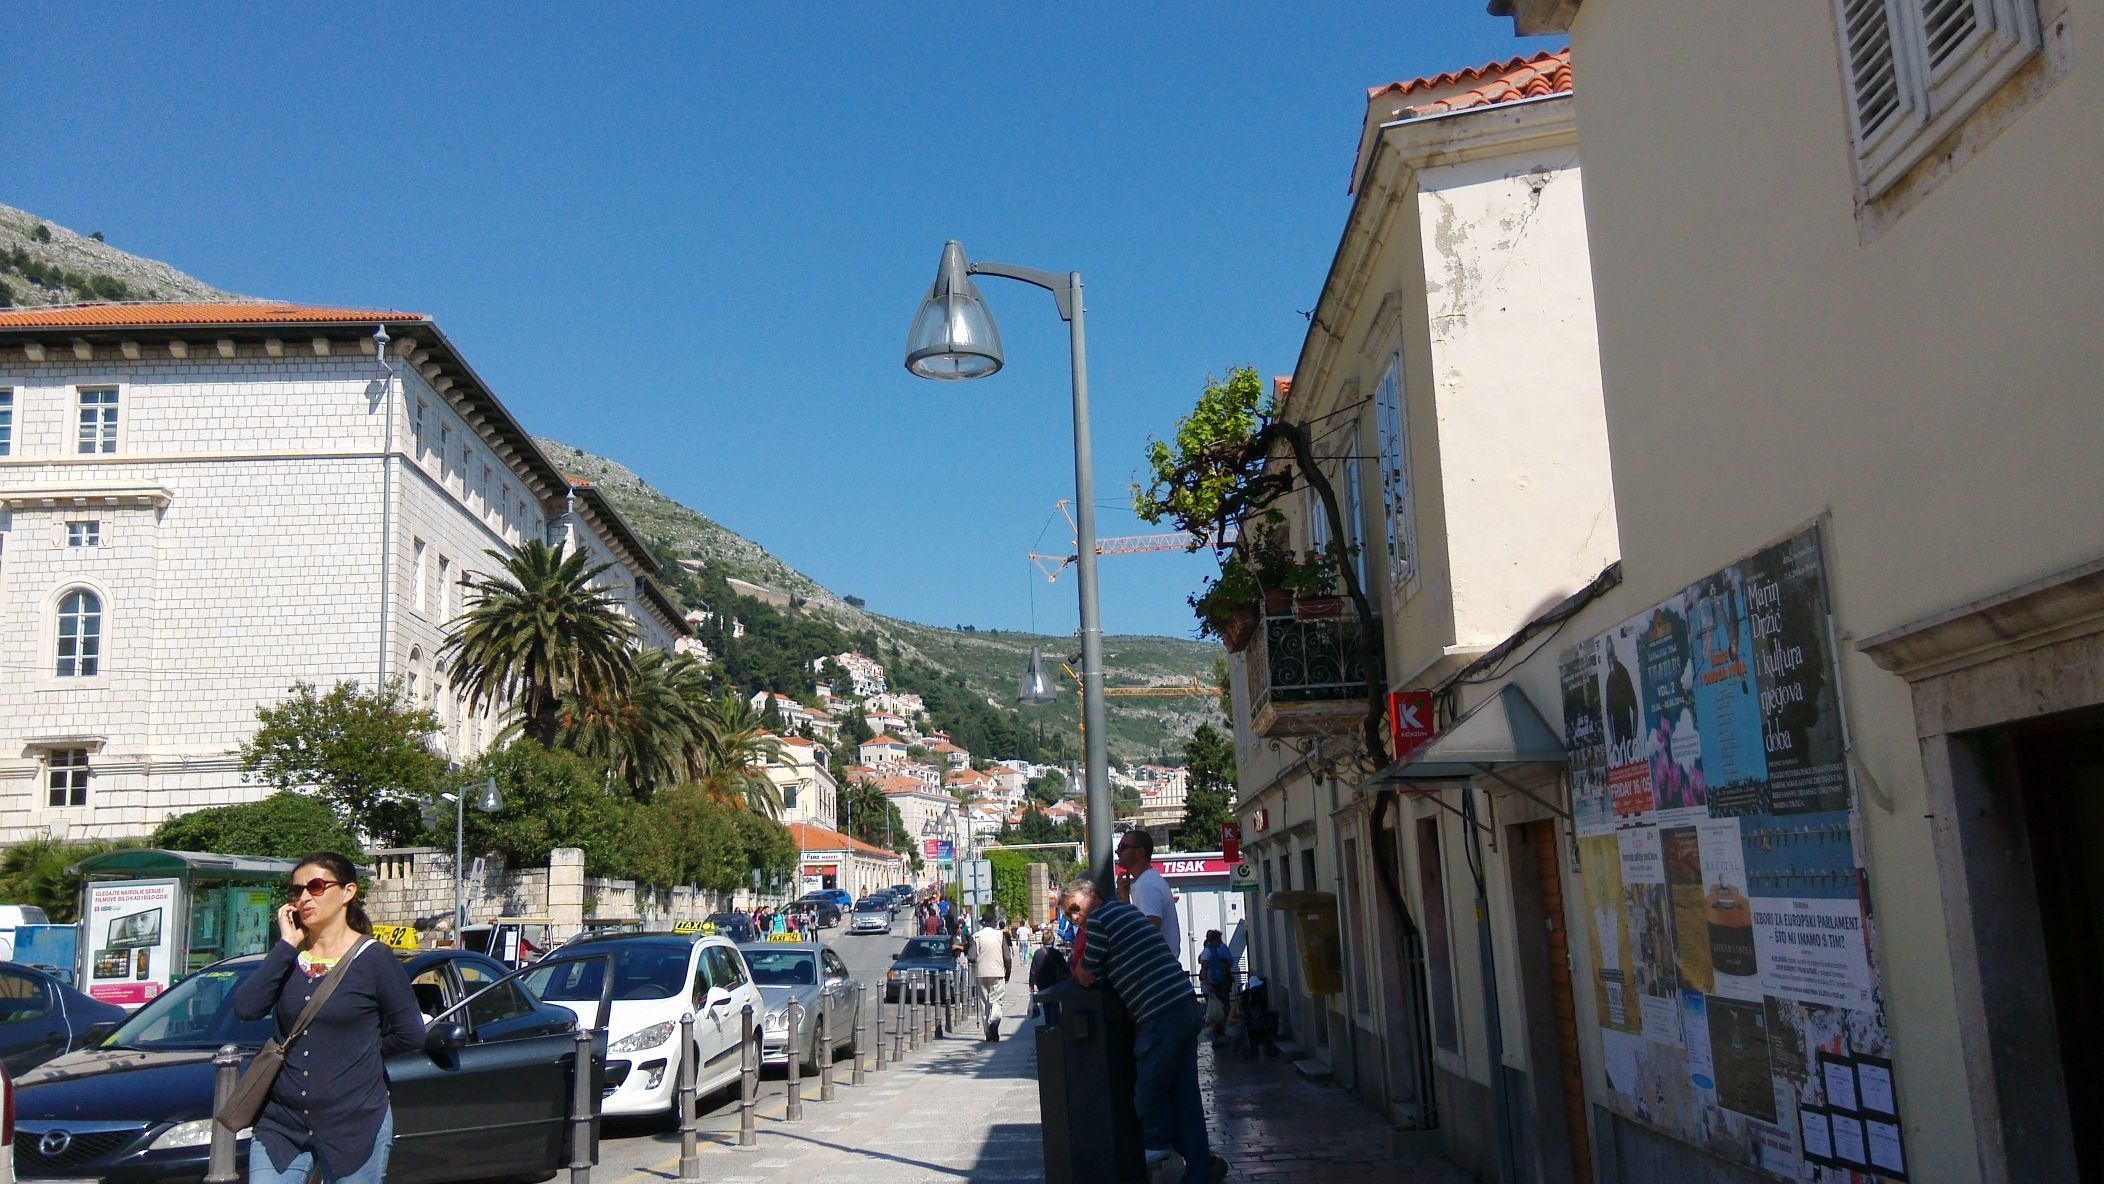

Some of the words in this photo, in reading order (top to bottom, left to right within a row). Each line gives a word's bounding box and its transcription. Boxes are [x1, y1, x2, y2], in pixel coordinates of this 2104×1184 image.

[1747, 579, 1780, 612] Marin
[1751, 608, 1781, 639] Držić
[1756, 652, 1761, 676] i
[1762, 638, 1803, 677] kultura
[1760, 681, 1803, 715] njegova
[1399, 704, 1424, 729] K
[1766, 717, 1792, 752] doba
[1611, 781, 1632, 799] FRIDAY
[1163, 860, 1205, 873] TISAK
[681, 921, 703, 930] TAXI
[1753, 912, 1774, 925] IZBORI
[1774, 913, 1783, 926] ZA
[1784, 914, 1816, 928] EUROPSKI
[1817, 915, 1859, 930] PARLAMENT
[390, 927, 407, 945] 92
[769, 934, 786, 942] TAXI
[1774, 928, 1786, 943] ŠTO
[1787, 932, 1796, 944] MI
[1797, 932, 1821, 946] IMAMO
[1822, 933, 1828, 947] S
[1828, 934, 1845, 949] TIM?
